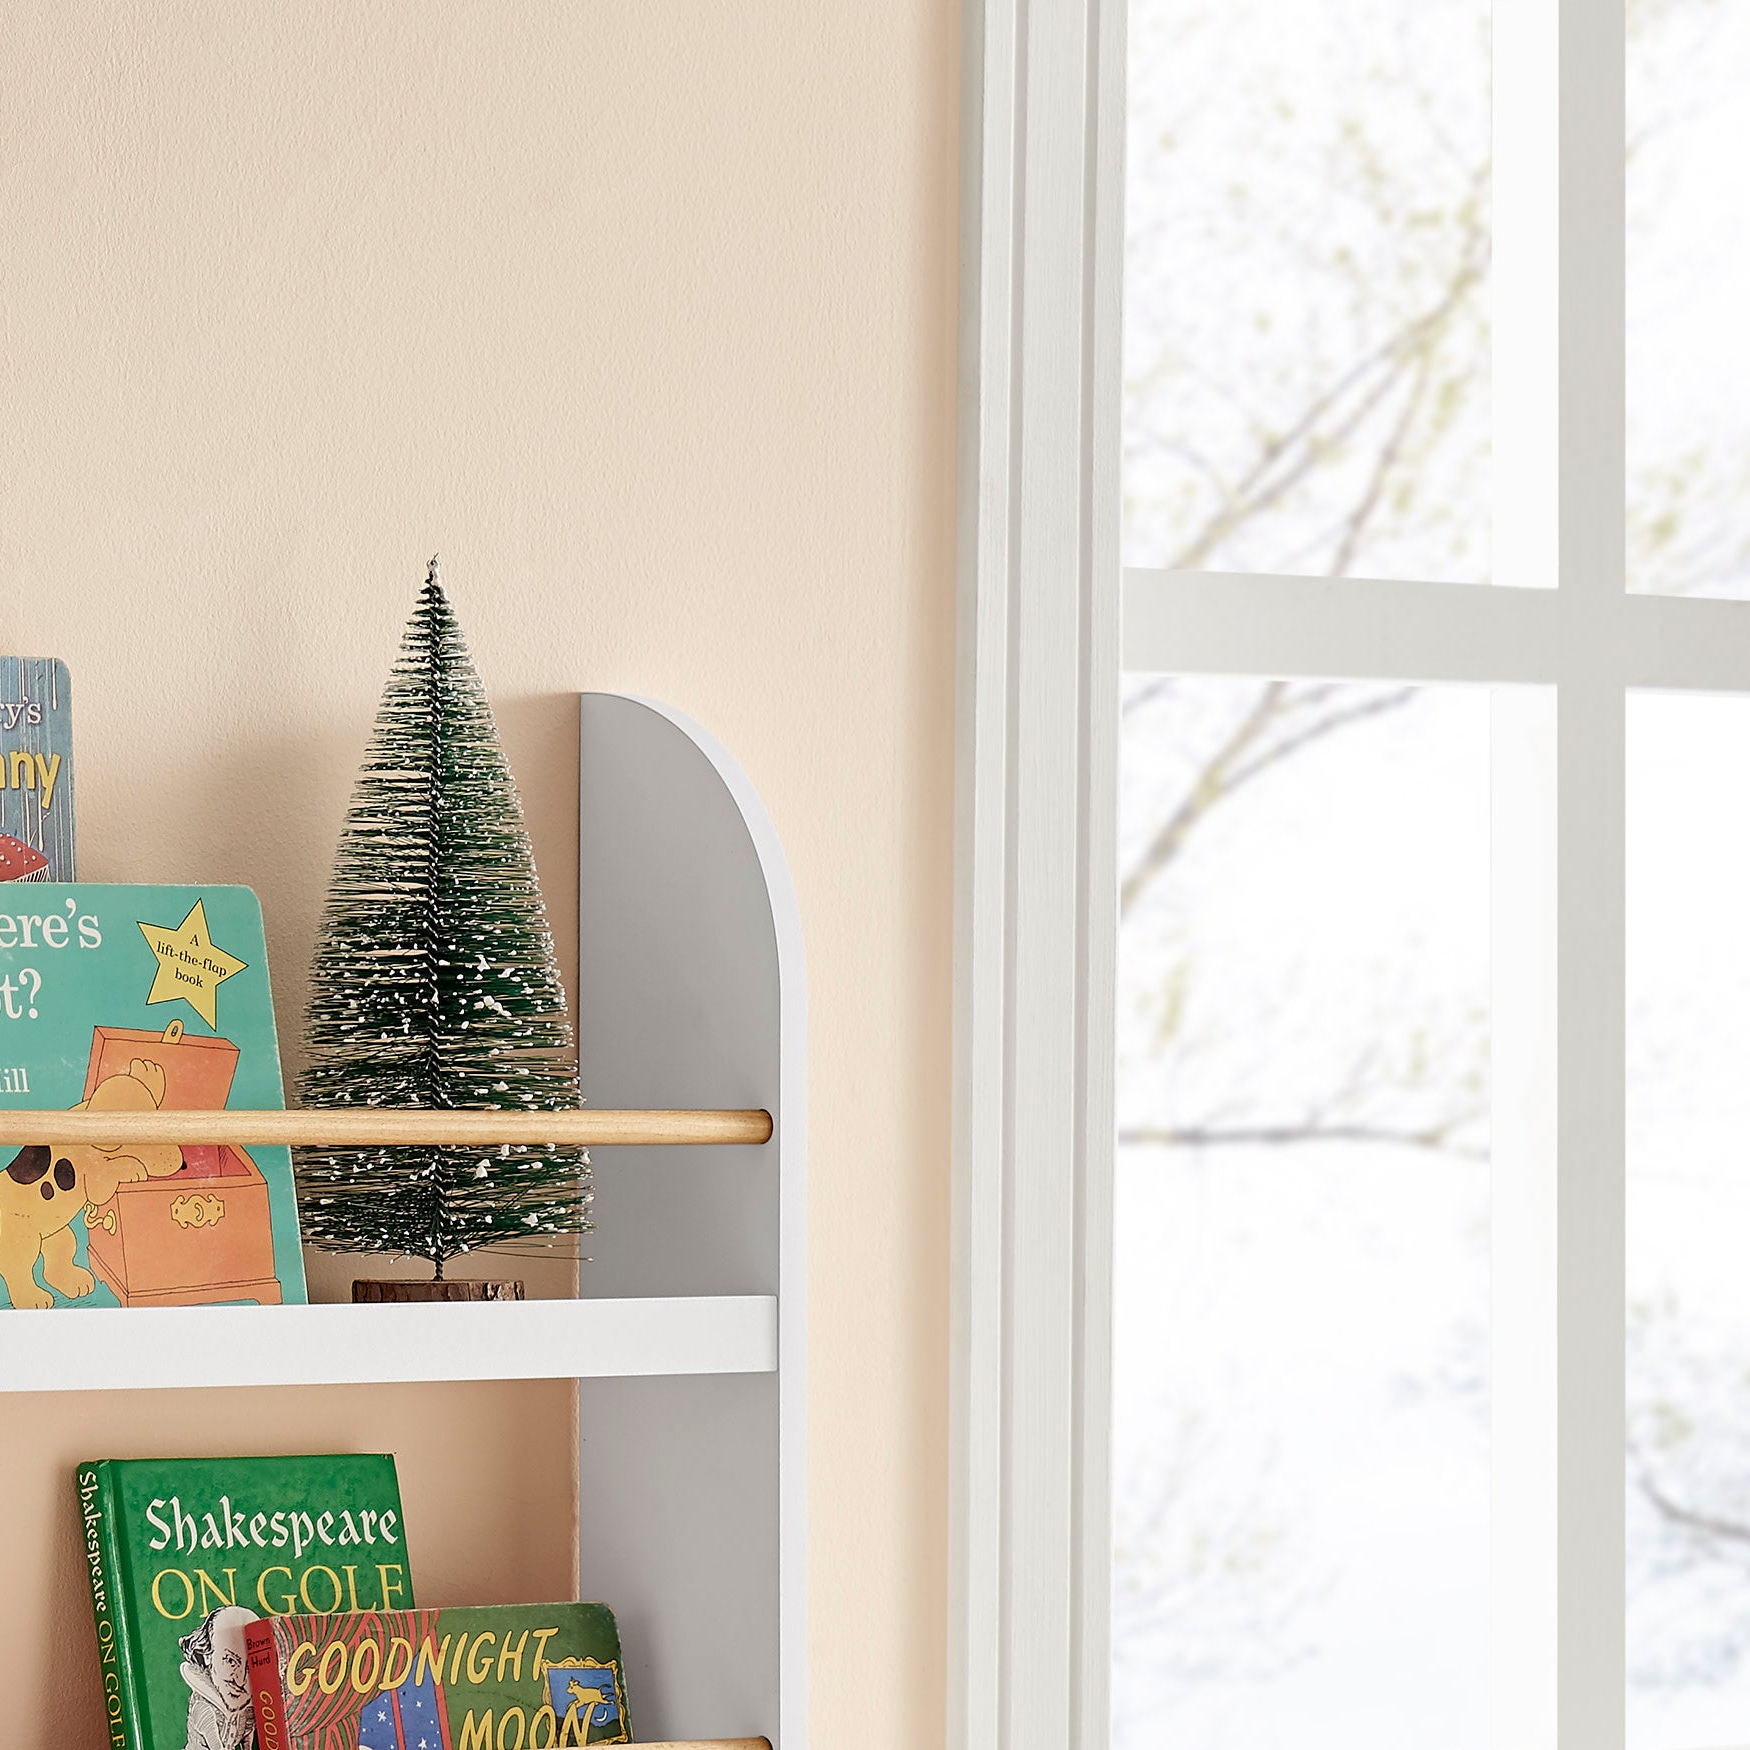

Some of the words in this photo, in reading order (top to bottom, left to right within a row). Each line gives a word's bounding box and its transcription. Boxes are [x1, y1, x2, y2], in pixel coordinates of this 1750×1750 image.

[156, 940, 227, 978] lift-the-flap
[189, 934, 200, 947] A
[174, 967, 204, 988] book
[79, 1470, 107, 1613] Shakespeare
[145, 1495, 399, 1559] Shakespeare
[150, 1568, 238, 1620] ON
[256, 1563, 404, 1617] GOLF
[99, 1619, 116, 1664] ON
[246, 1637, 271, 1651] Brown
[251, 1655, 271, 1669] Hurd
[286, 1627, 560, 1697] GOODNIGHT
[105, 1672, 126, 1748] GOLF
